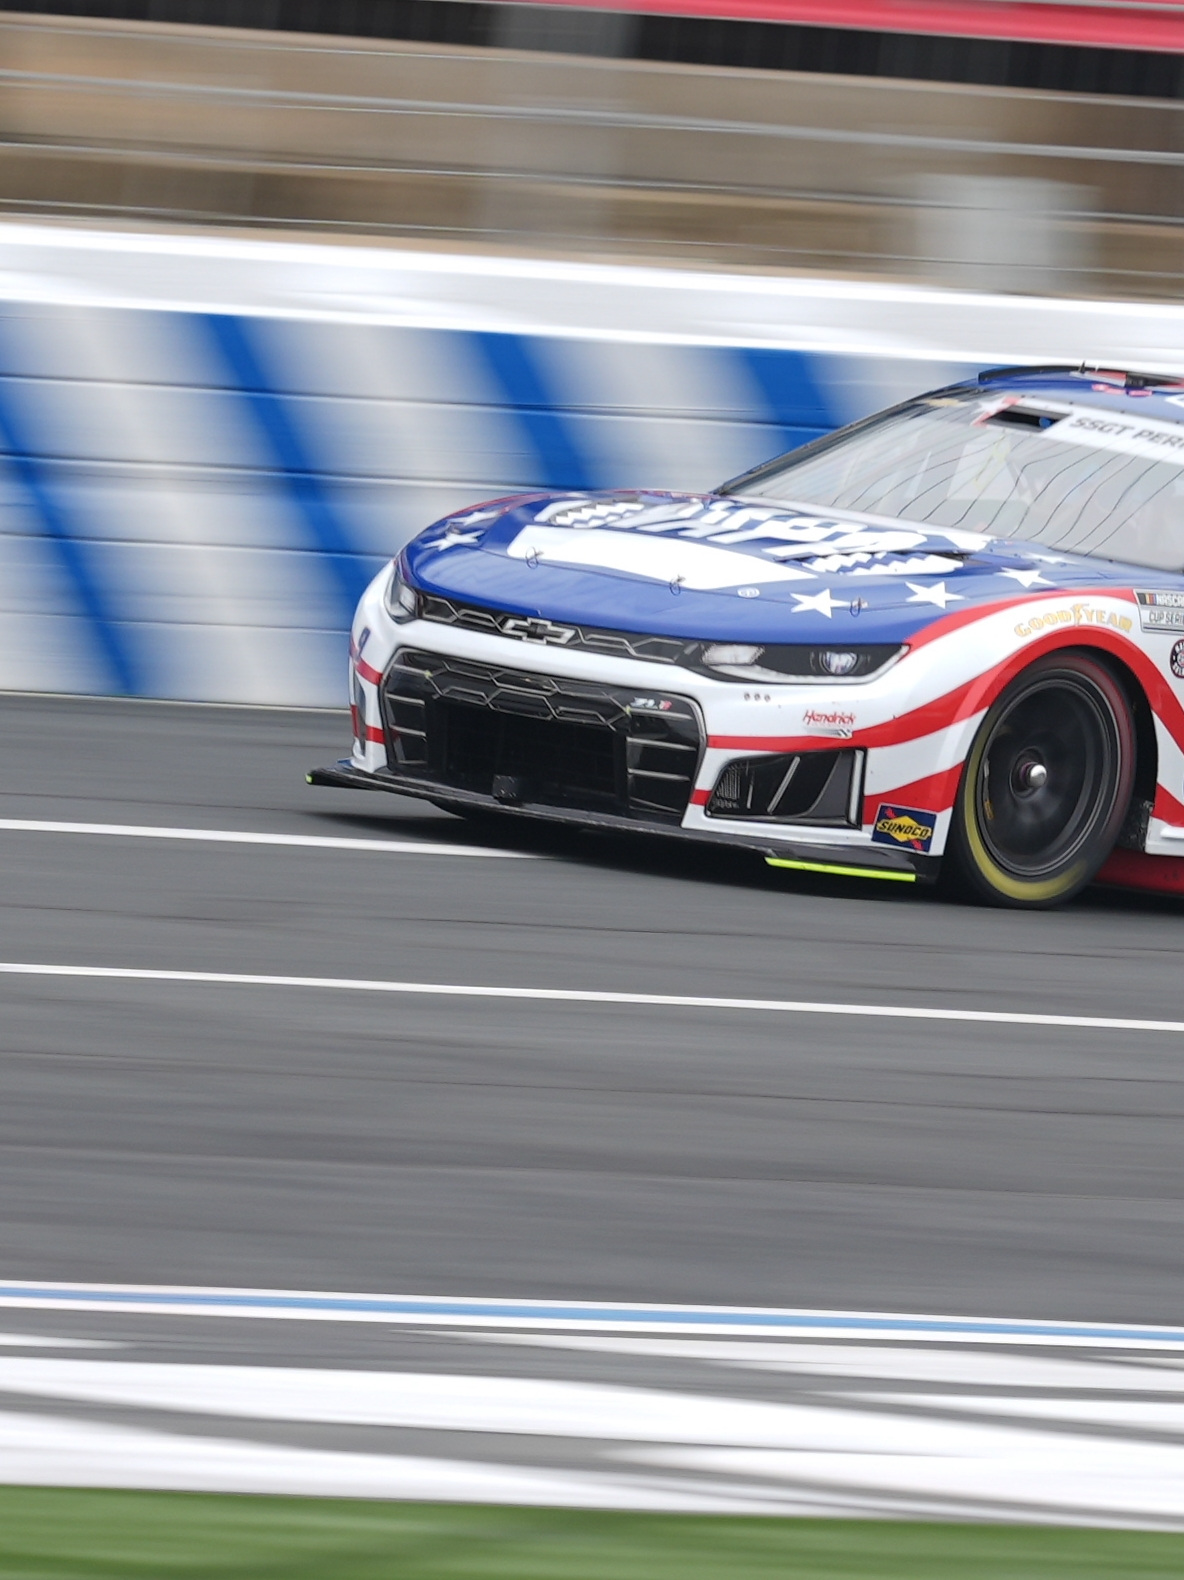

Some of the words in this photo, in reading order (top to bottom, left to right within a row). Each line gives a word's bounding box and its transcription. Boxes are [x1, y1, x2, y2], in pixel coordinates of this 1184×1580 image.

[1070, 416, 1135, 436] SSGT
[1014, 603, 1134, 638] GOODYEAR
[1149, 610, 1165, 623] CUP
[803, 710, 857, 725] Hendrick
[878, 820, 931, 838] SUNOCO
